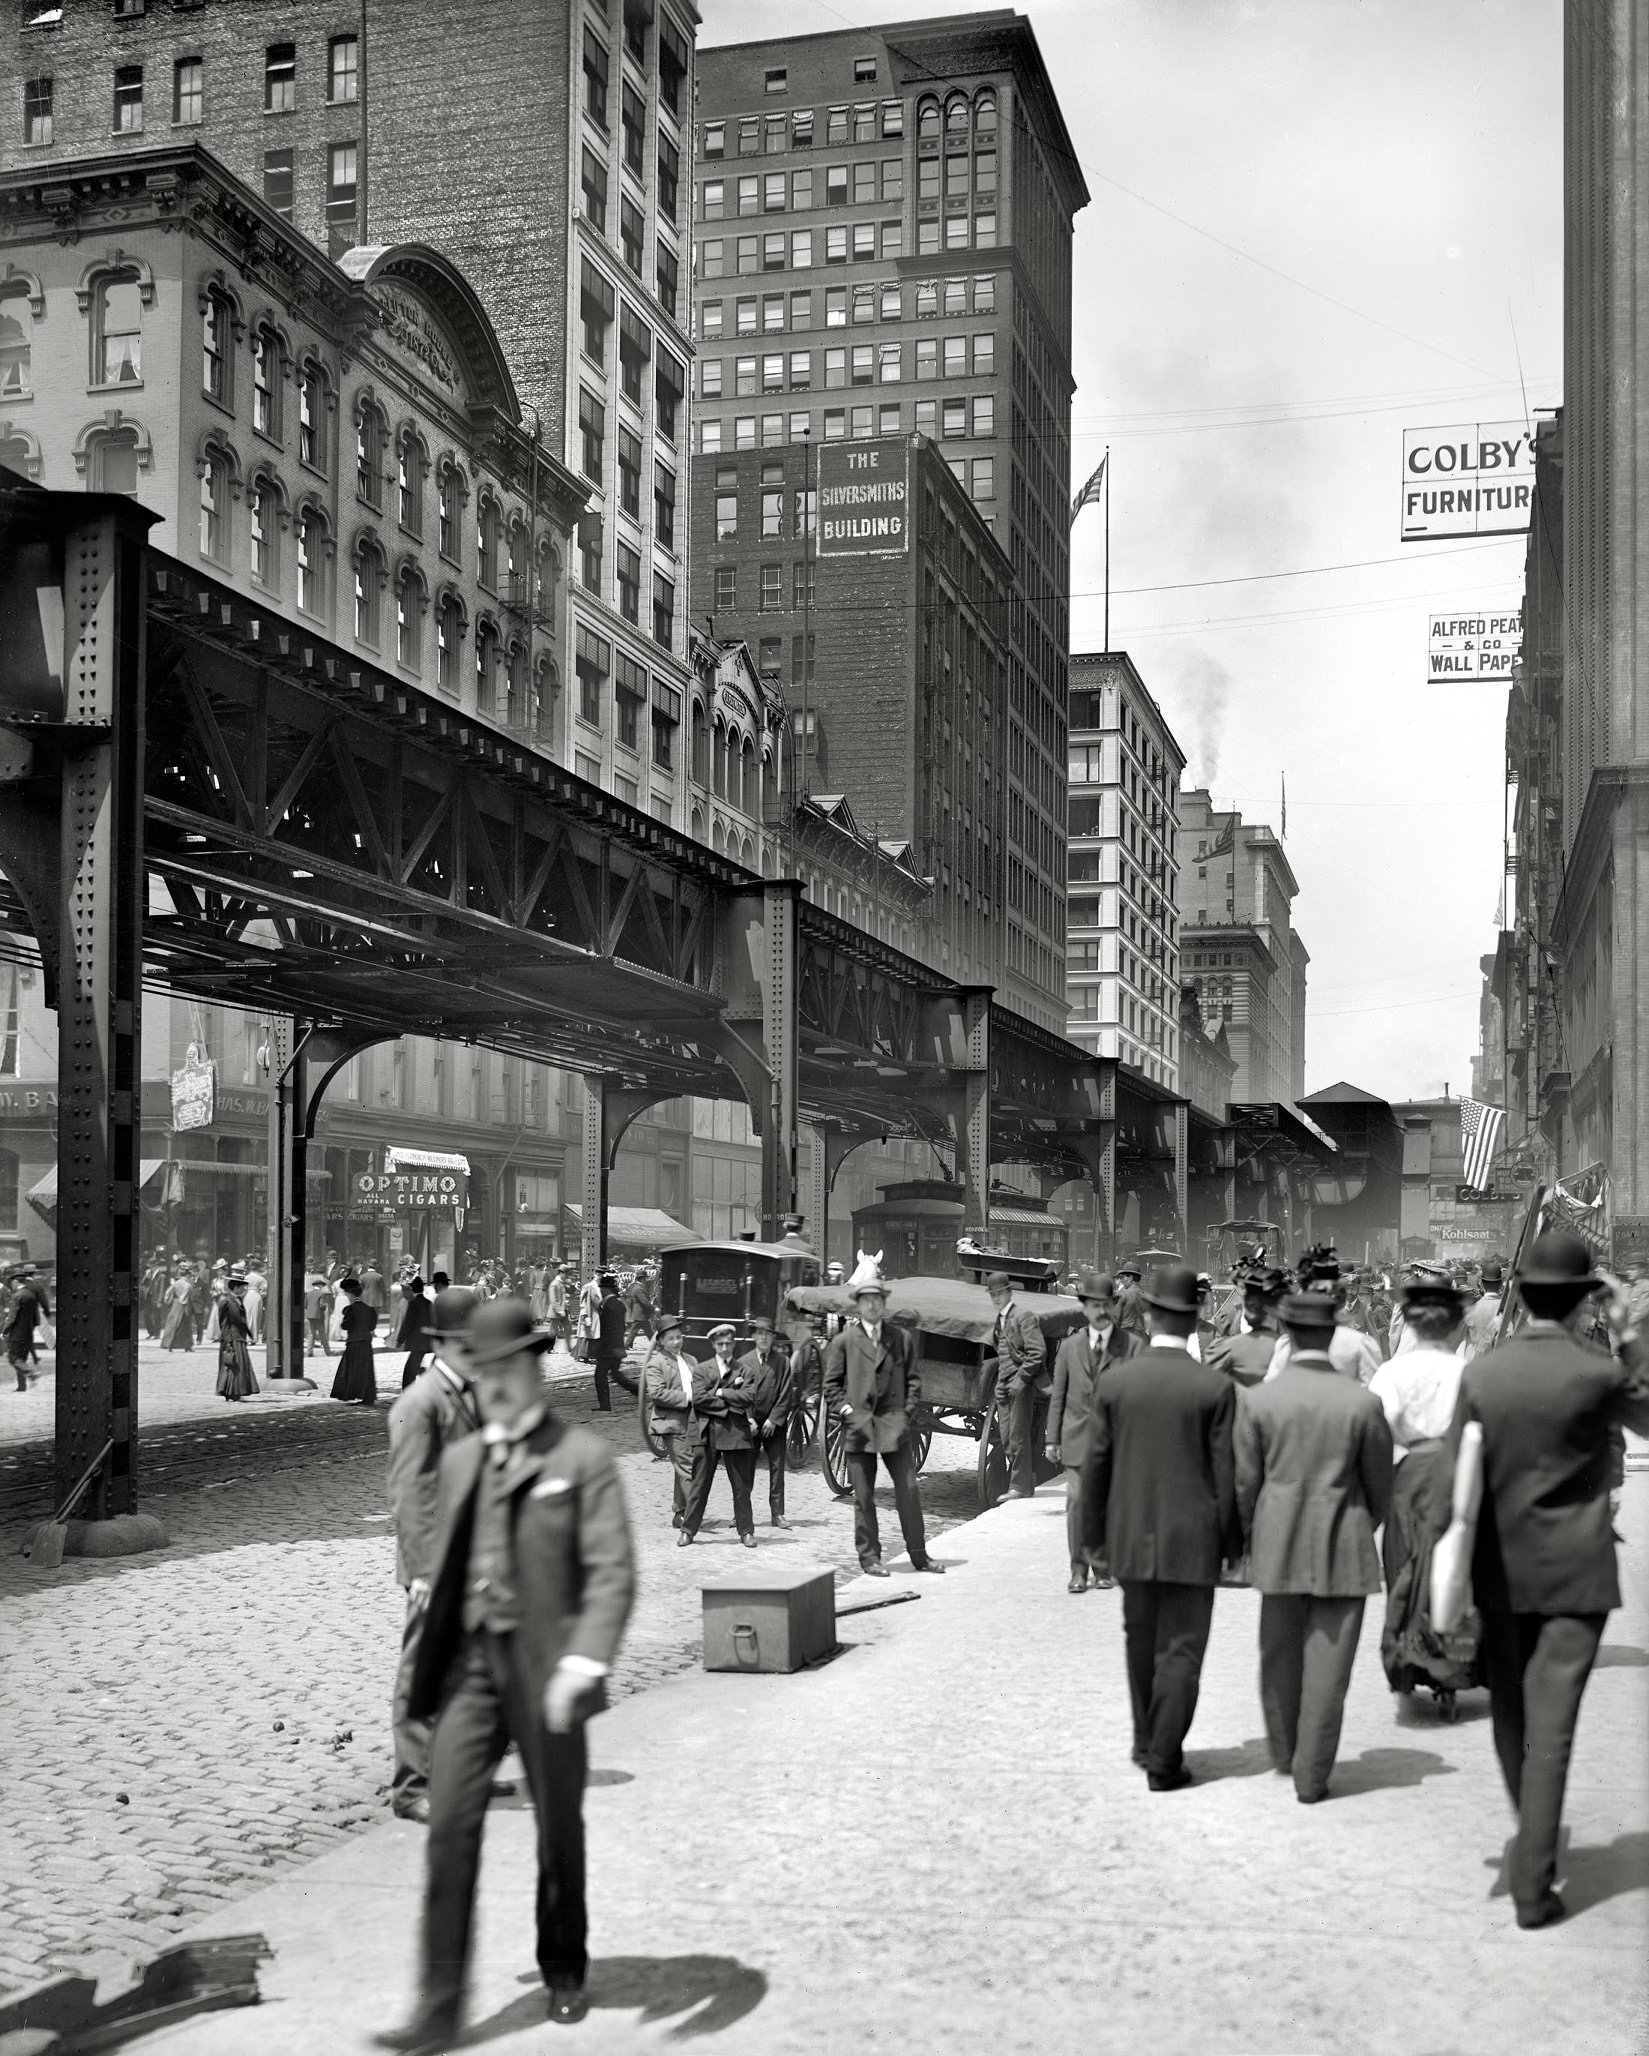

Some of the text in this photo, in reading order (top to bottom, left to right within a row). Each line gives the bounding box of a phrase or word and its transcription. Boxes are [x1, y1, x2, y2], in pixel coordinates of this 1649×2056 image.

[847, 452, 879, 469] THE
[822, 481, 904, 506] SILVERSMITHS
[1407, 484, 1533, 516] FURNITUR
[824, 517, 902, 539] BUILDING
[1432, 620, 1486, 637] ALFRED
[1464, 640, 1501, 651] & CO
[1431, 655, 1473, 672] WALL
[217, 1096, 245, 1113] HAS.
[359, 1175, 456, 1192] OPTIMO
[397, 1194, 460, 1205] CIGARS
[1460, 1187, 1520, 1200] COLB
